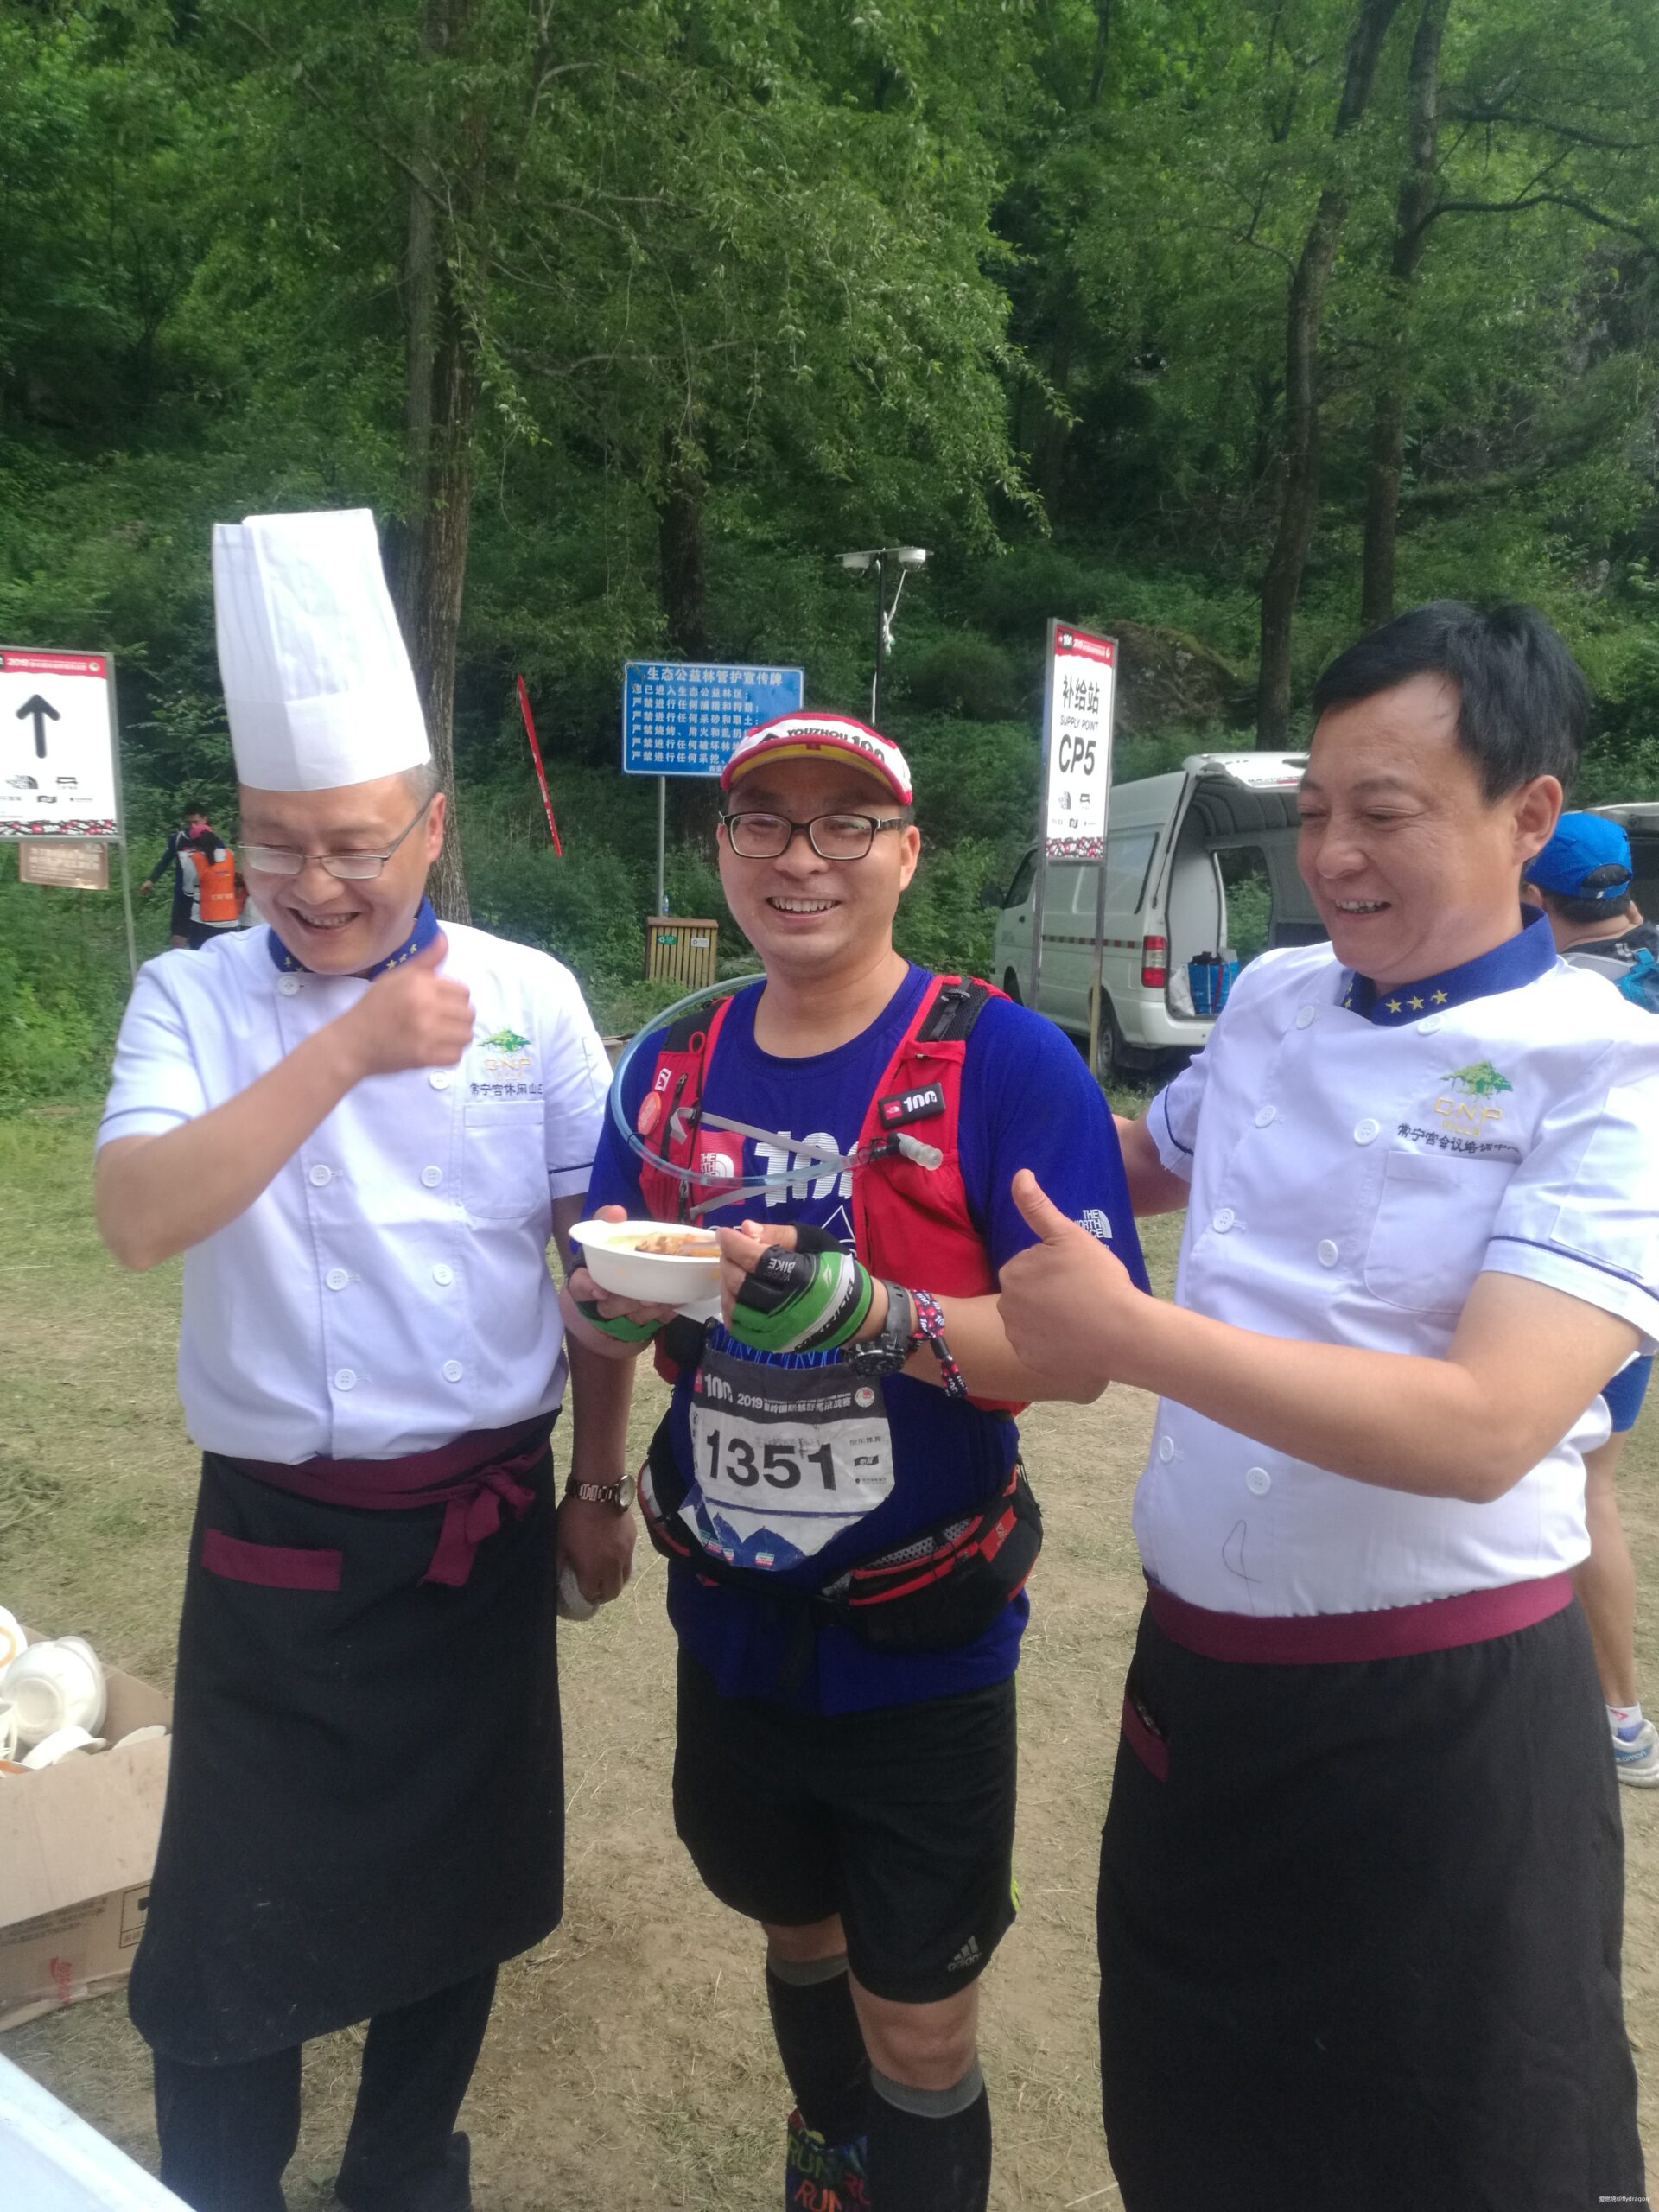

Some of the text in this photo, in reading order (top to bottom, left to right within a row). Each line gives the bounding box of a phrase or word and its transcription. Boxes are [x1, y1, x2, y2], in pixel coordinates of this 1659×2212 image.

[647, 668, 783, 686] 生态公益林管护宣传牌
[1062, 674, 1101, 715] 补给站
[1059, 715, 1099, 732] SUPPLY POINT
[786, 728, 849, 741] YOUZHOU
[1058, 734, 1096, 776] CP5
[903, 1090, 938, 1113] 100
[1082, 1209, 1100, 1219] THE
[767, 1257, 797, 1274] BIKE
[736, 1393, 764, 1410] 2019
[706, 1429, 836, 1491] 1351
